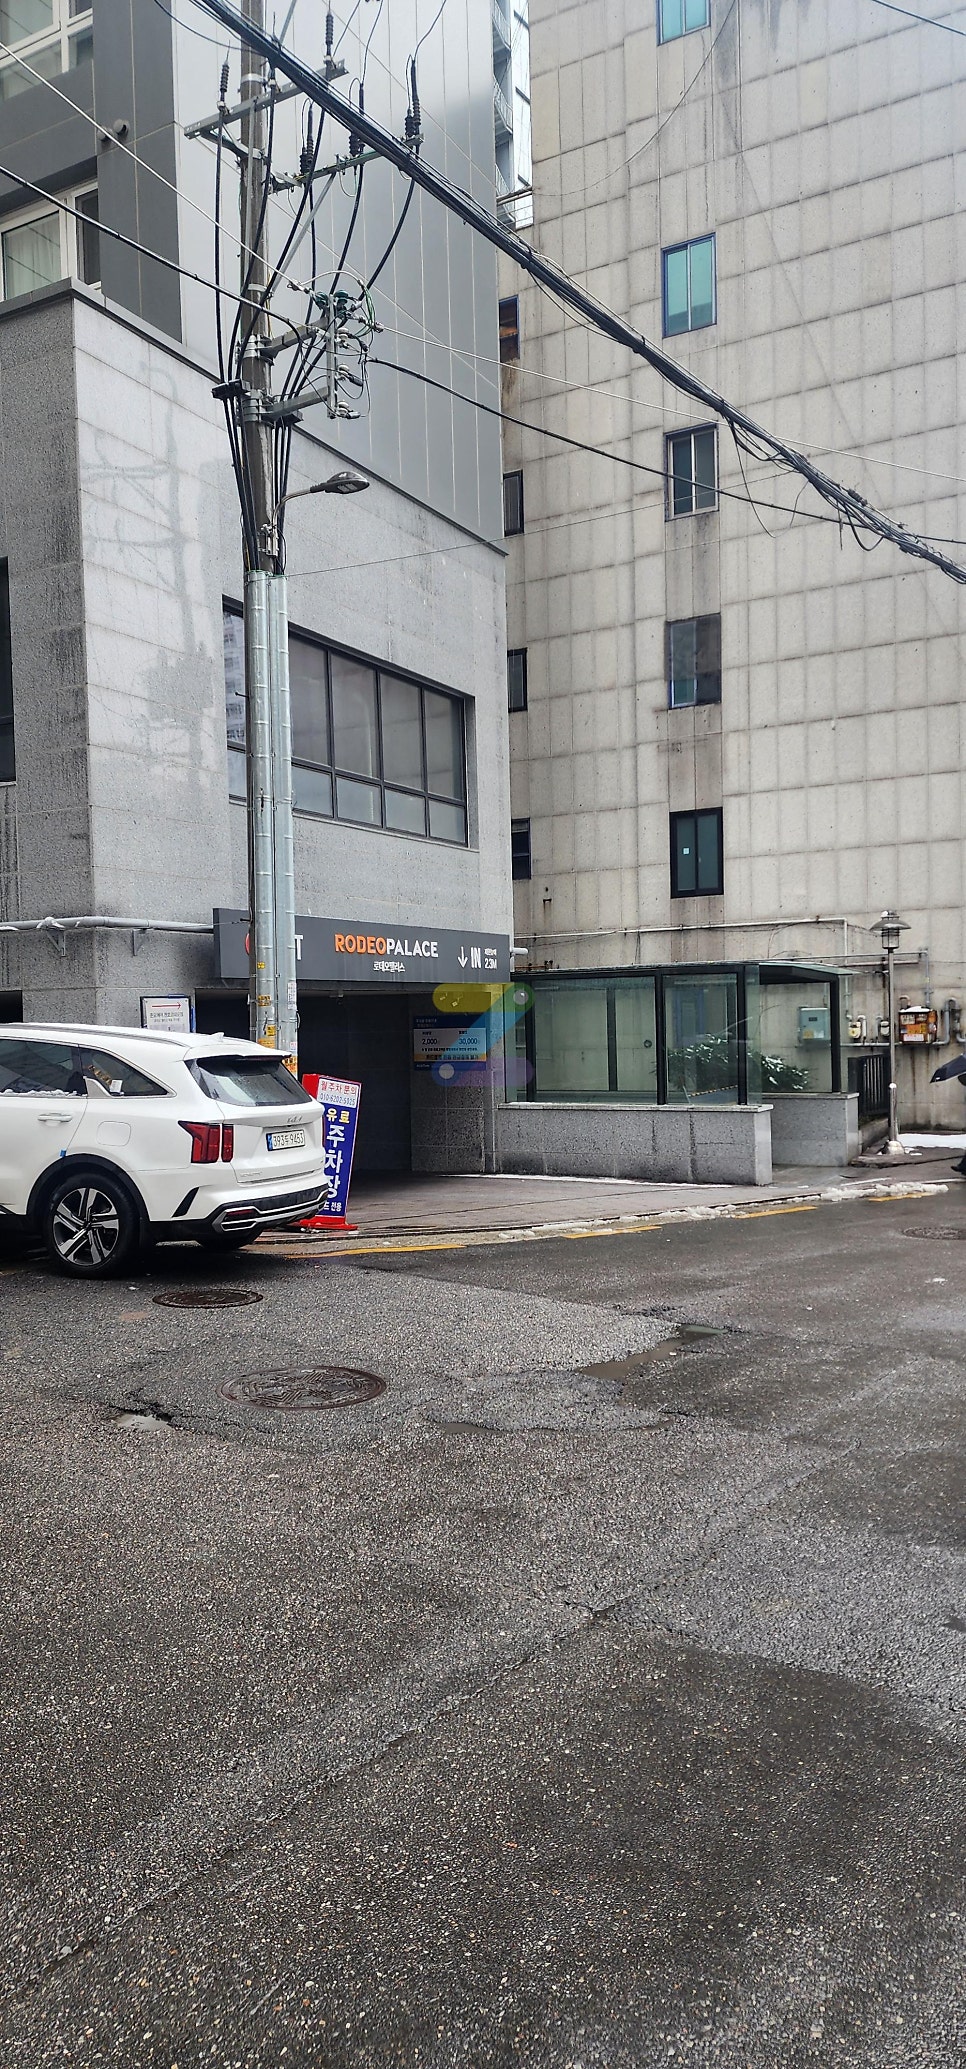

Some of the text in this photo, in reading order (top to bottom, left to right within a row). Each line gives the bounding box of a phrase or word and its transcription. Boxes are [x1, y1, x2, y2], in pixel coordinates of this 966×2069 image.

[334, 933, 439, 958] RODEOPALACE
[470, 946, 482, 969] IN
[326, 1108, 350, 1124] 유료
[324, 1124, 346, 1199] 주차장
